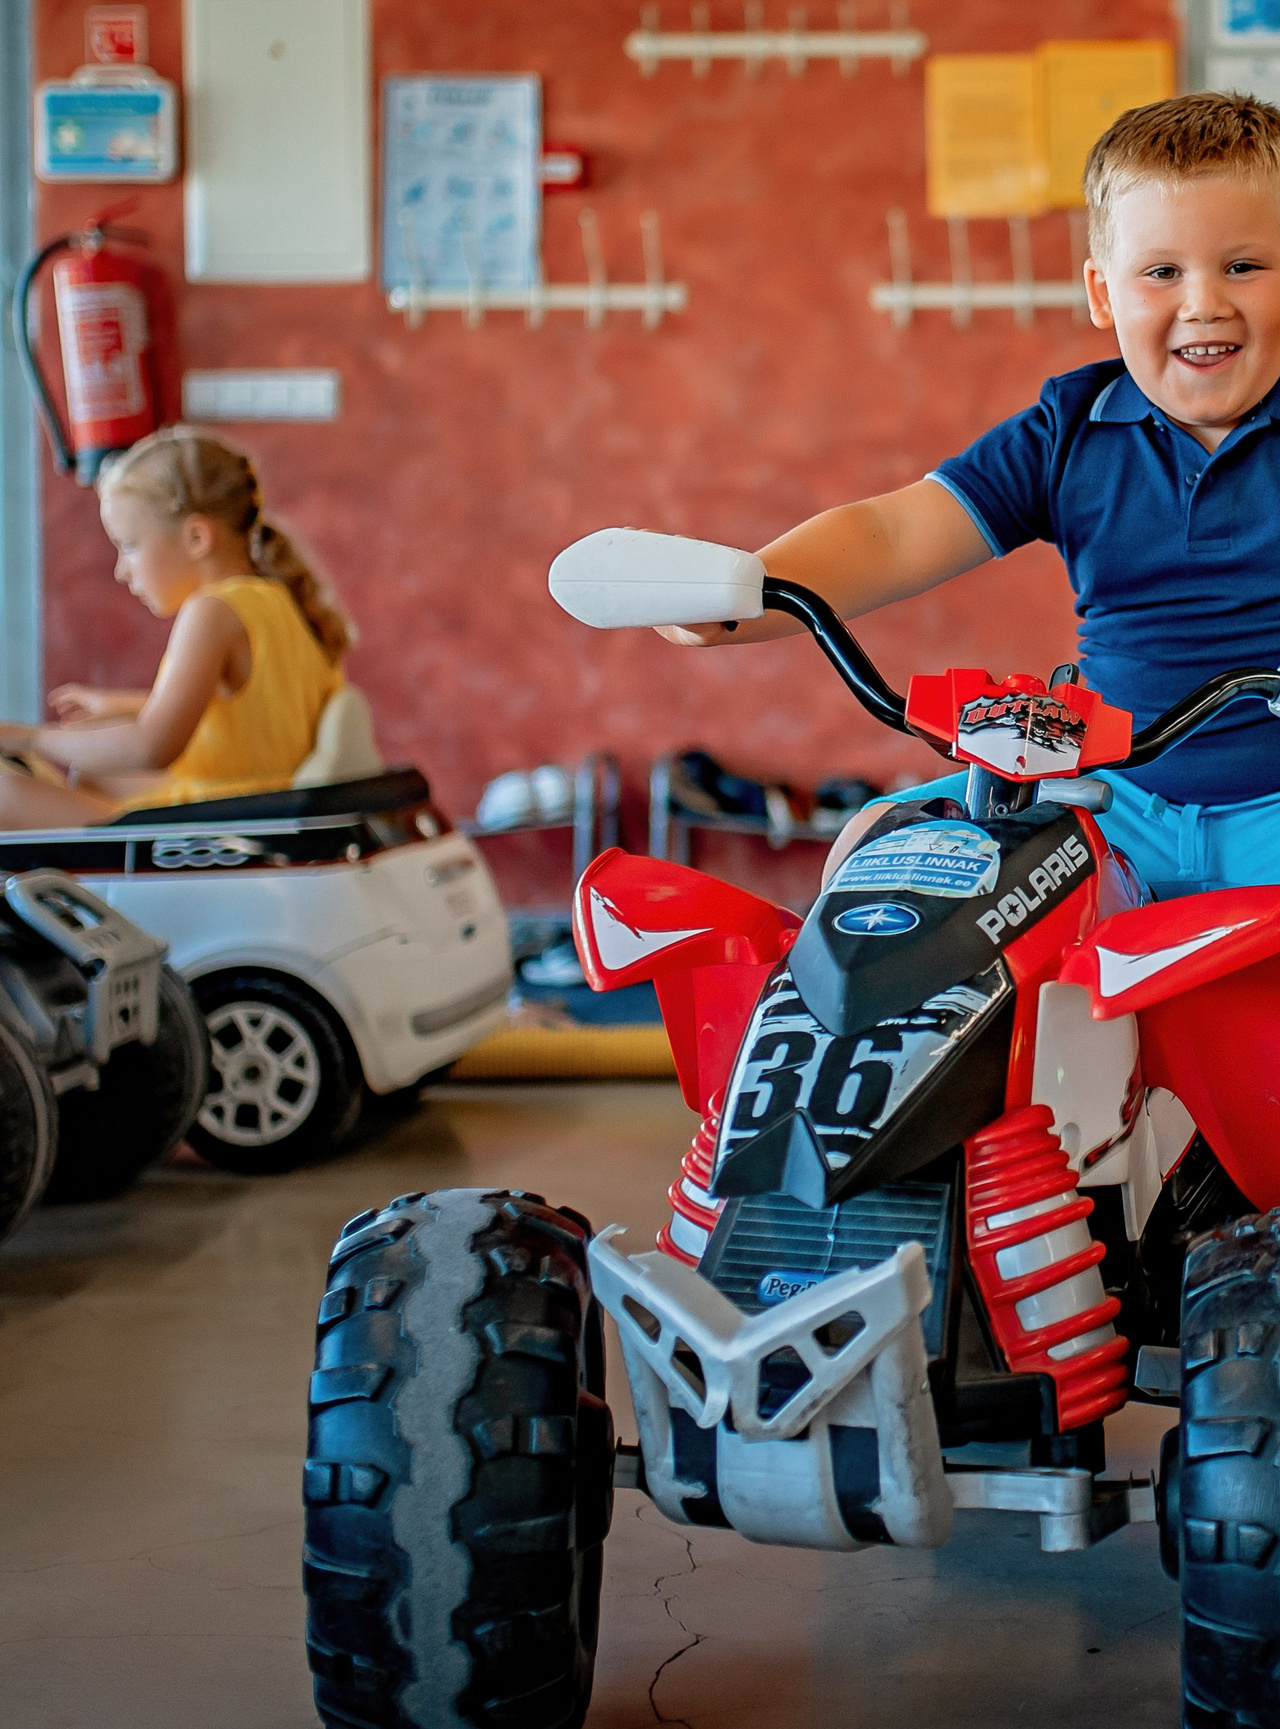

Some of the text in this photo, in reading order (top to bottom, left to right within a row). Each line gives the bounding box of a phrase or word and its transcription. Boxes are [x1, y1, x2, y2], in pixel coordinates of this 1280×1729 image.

[964, 699, 1082, 726] OUTLAW
[851, 855, 982, 872] LIIKLUSLINNAK
[975, 834, 1089, 945] POLARIS
[730, 1031, 904, 1130] 36
